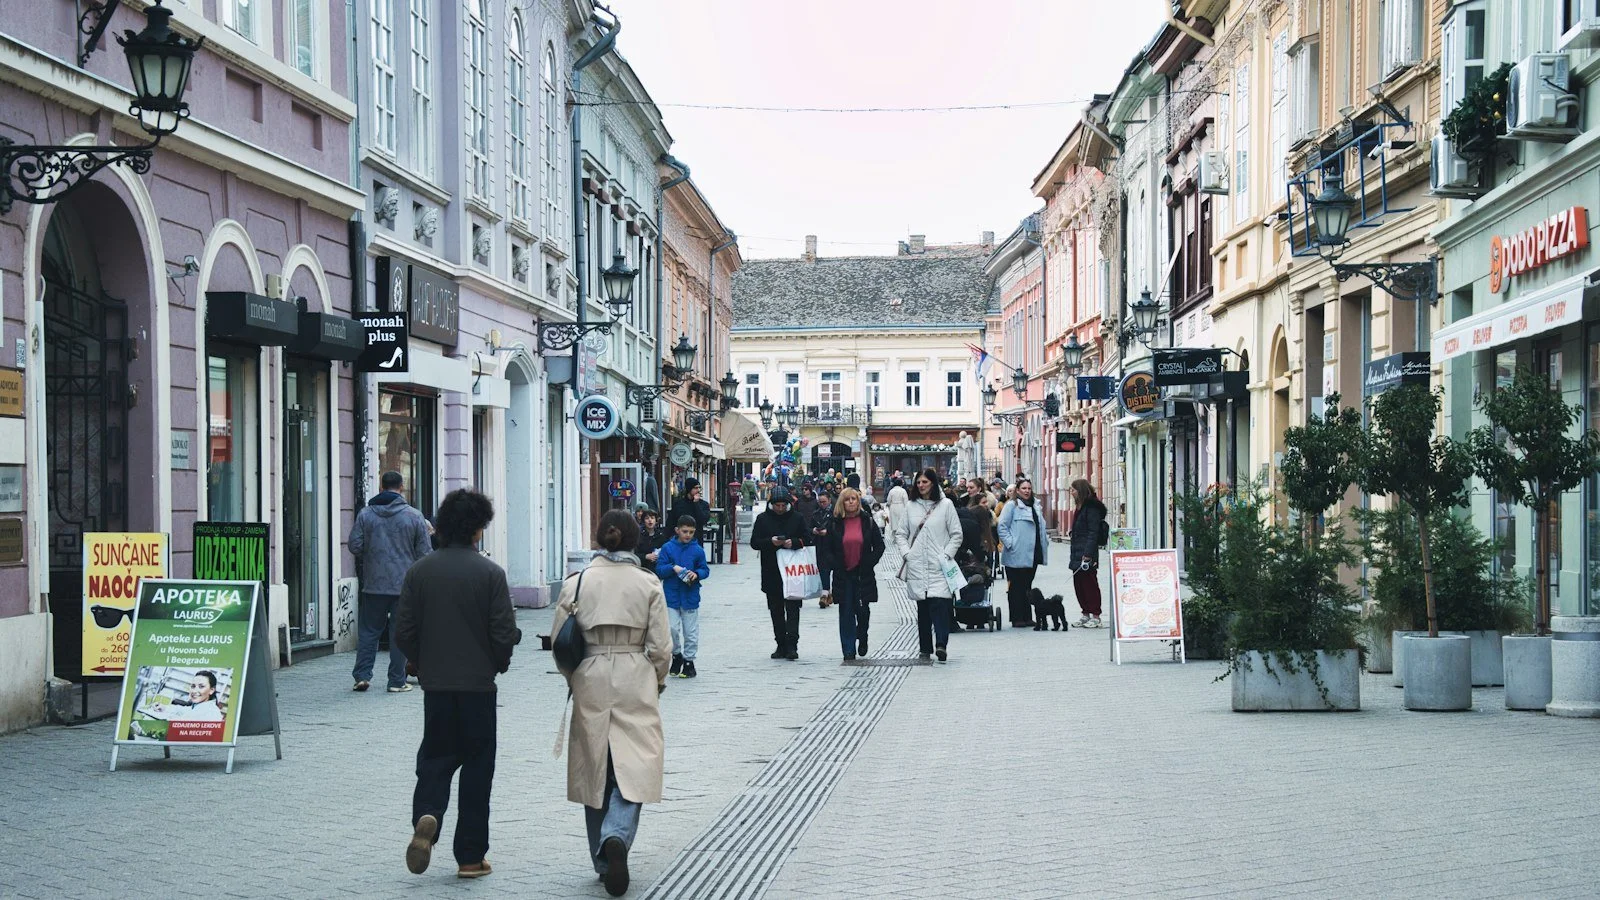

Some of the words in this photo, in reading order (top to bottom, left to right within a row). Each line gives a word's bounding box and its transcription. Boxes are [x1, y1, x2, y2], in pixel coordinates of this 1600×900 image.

[1502, 226, 1535, 277] DODO
[1537, 206, 1577, 264] PIZZA
[250, 301, 275, 322] monah
[324, 319, 346, 340] monah
[368, 329, 396, 345] plus
[1157, 362, 1183, 370] CRYSTAL
[1126, 394, 1160, 408] DISTRICT
[586, 420, 607, 429] MIX
[613, 481, 630, 489] PLAY
[612, 489, 631, 497] ZONE
[196, 525, 220, 533] PRODAJA
[223, 526, 241, 534] OTKUP
[244, 526, 266, 534] ZAMENA
[94, 536, 159, 566] SUNČANE
[195, 533, 265, 581] UDŽBENIKA
[89, 567, 163, 599] NAOČ
[151, 588, 241, 605] APOTEKA
[173, 610, 215, 620] LAURUS
[116, 632, 130, 641] 60
[149, 633, 191, 644] Apoteke
[193, 635, 233, 644] LAURUS
[167, 646, 197, 654] Novom
[198, 646, 219, 654] Sadu
[166, 655, 170, 663] i
[171, 656, 210, 665] Beogradu
